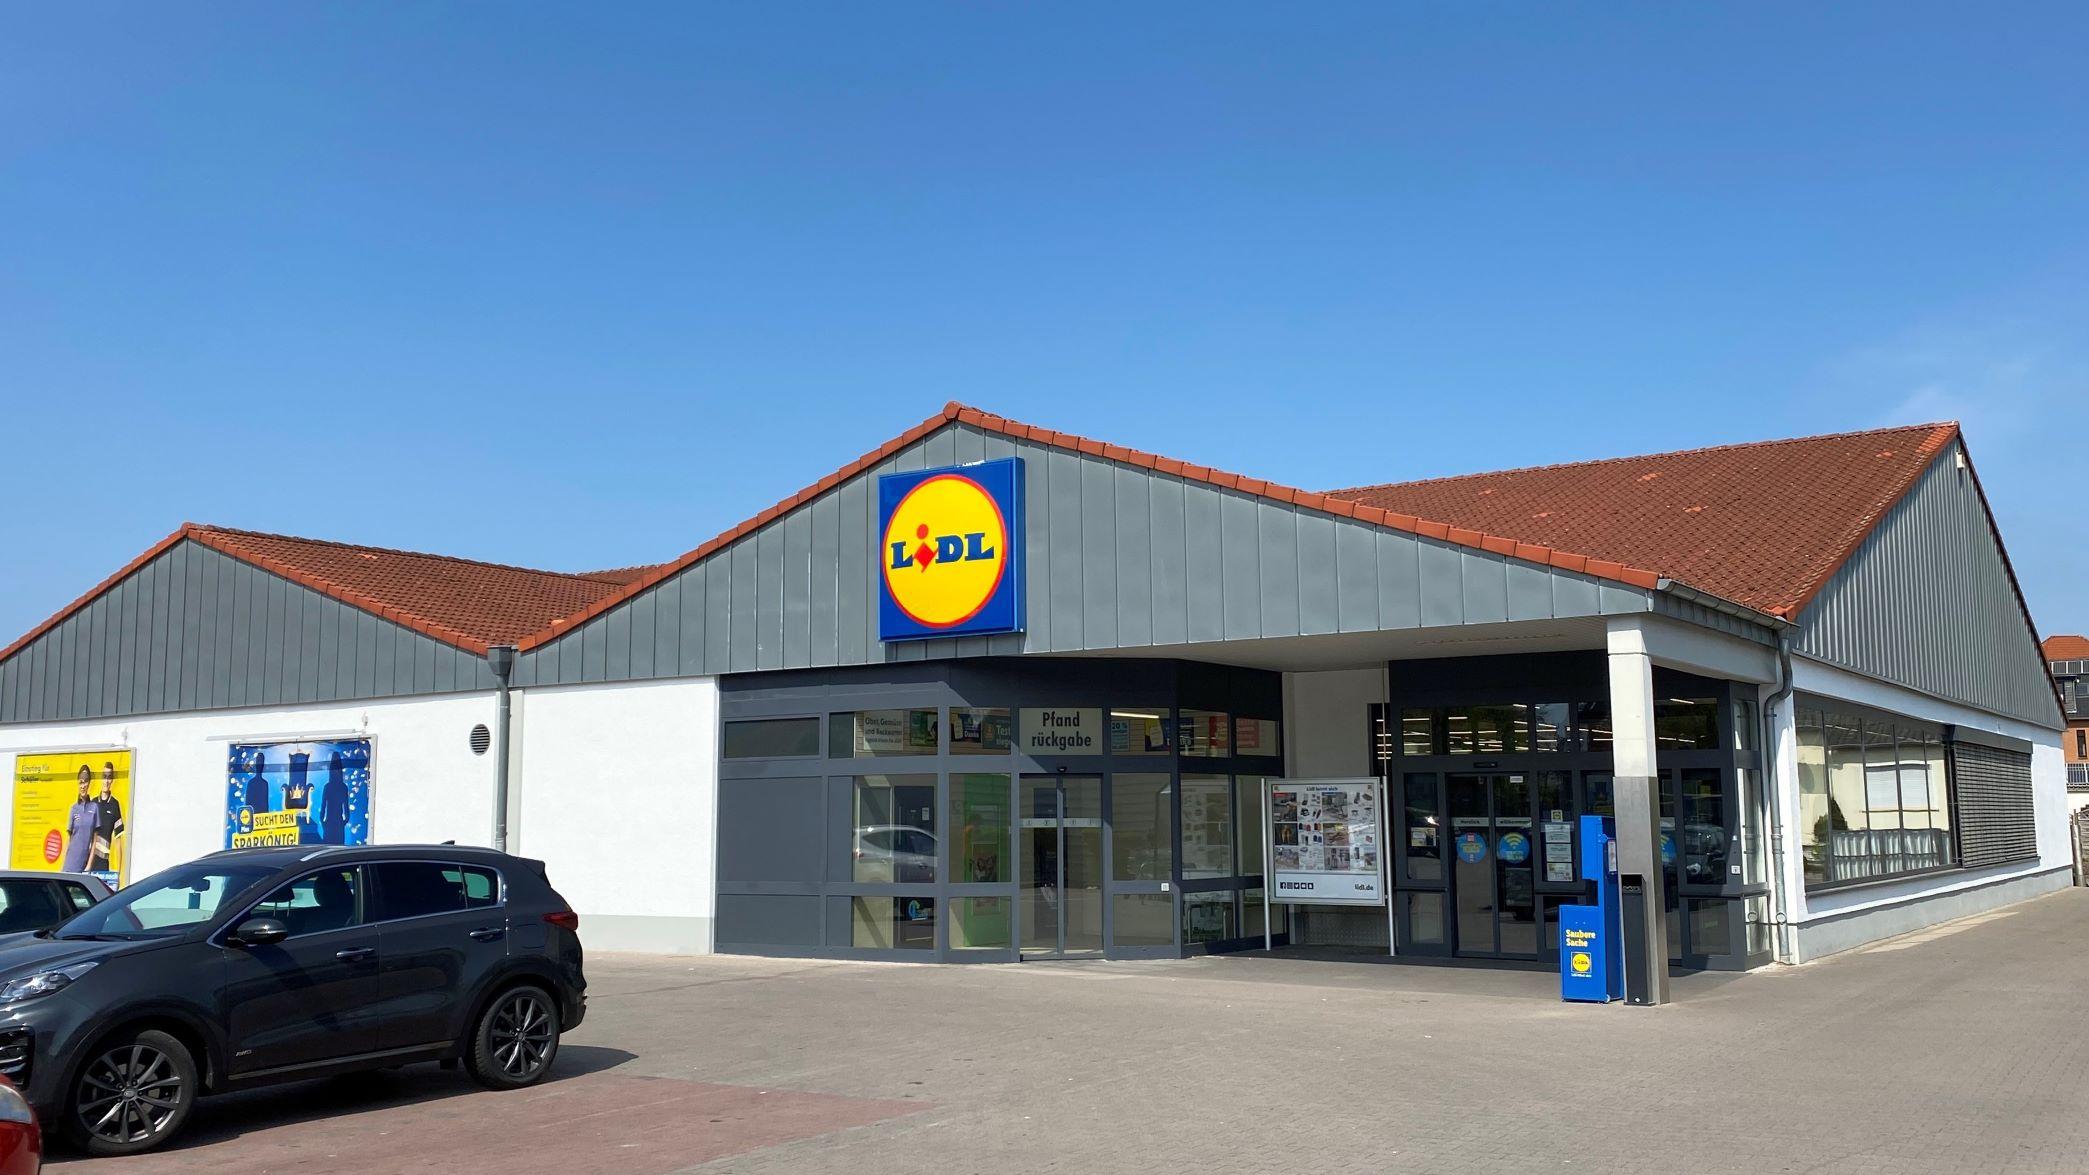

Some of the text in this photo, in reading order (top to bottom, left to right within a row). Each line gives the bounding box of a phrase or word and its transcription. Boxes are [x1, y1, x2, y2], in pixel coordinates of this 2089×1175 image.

[1042, 711, 1080, 727] Pfand
[1031, 731, 1092, 751] rückgabe
[255, 814, 278, 827] SUCHT
[280, 813, 294, 824] DEN
[233, 831, 297, 848] SPARKÖNIG!
[1565, 929, 1596, 939] Saubere
[1565, 938, 1588, 948] Sache
